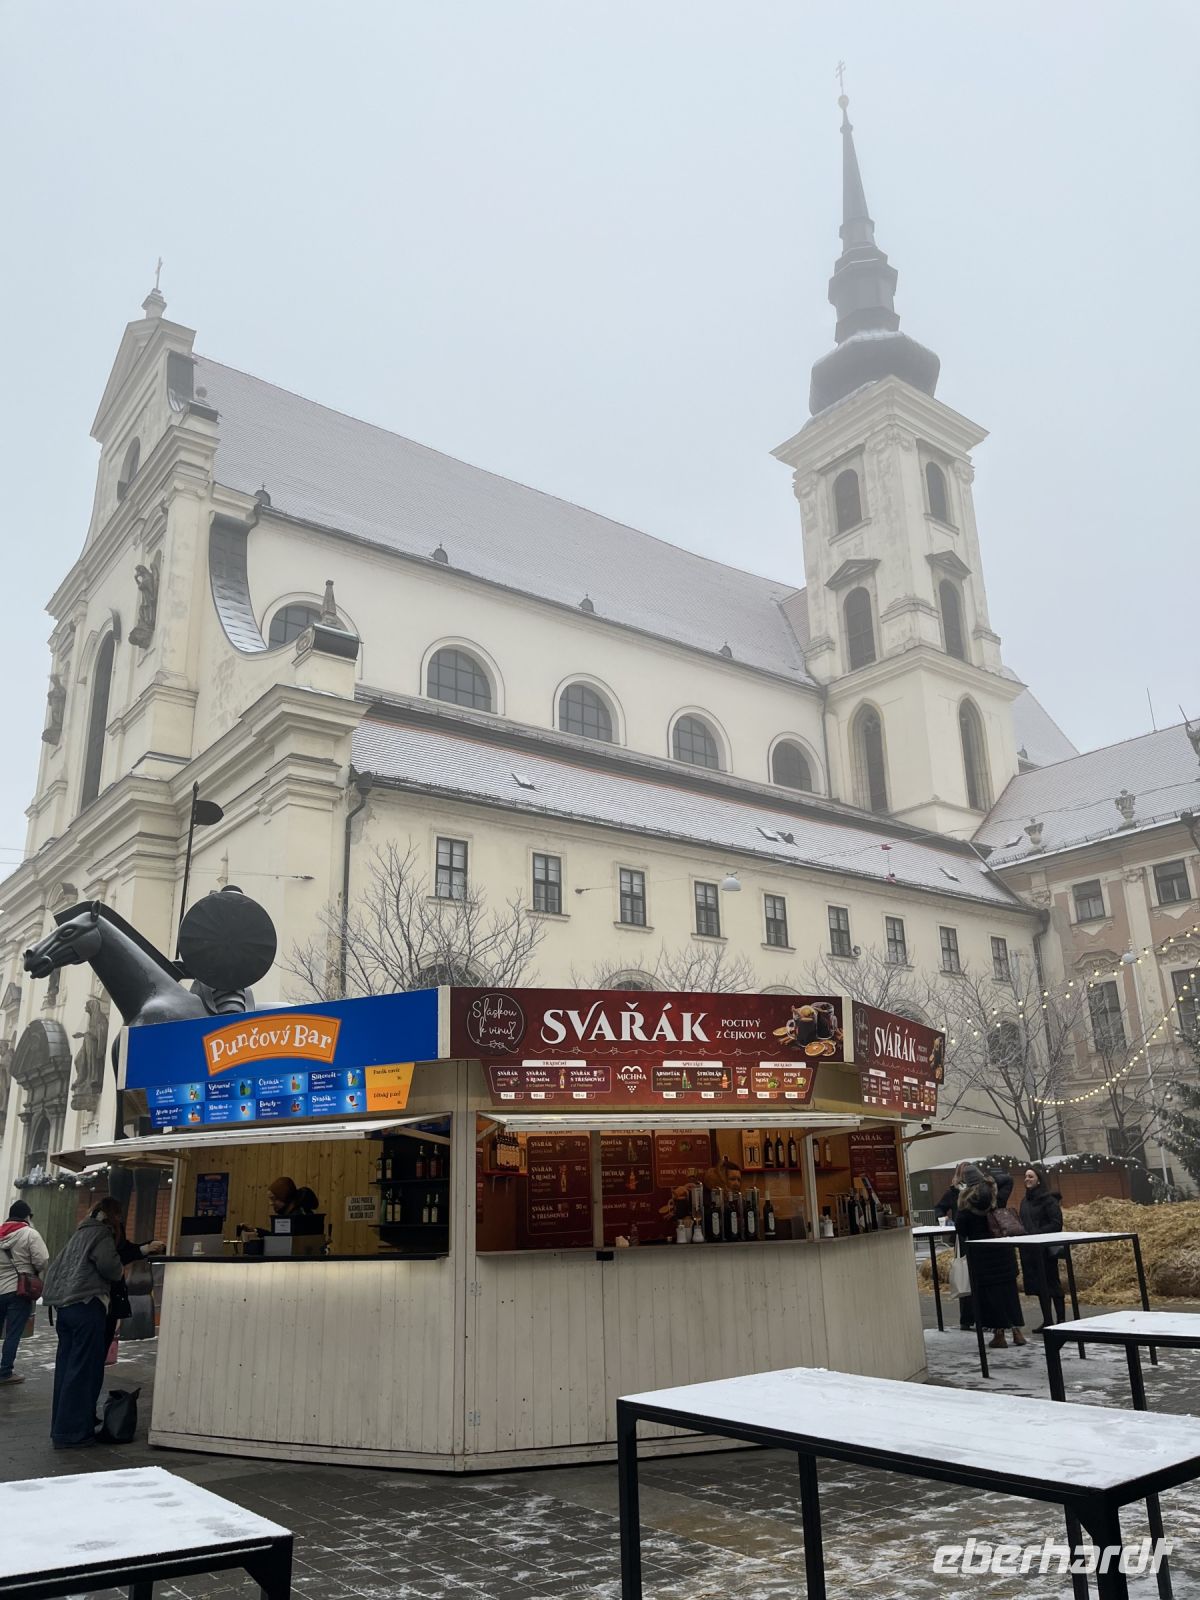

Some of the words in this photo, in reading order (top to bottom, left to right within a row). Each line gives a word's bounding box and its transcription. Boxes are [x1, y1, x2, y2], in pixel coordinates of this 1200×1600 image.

[540, 1000, 712, 1044] SVAŘÁK
[716, 1030, 722, 1039] Z
[723, 1029, 767, 1040] ČEJKOVIC
[721, 1018, 761, 1028] POCTIVÝ
[209, 1025, 291, 1063] Punčový
[293, 1024, 332, 1048] Bar
[874, 1022, 916, 1063] SVAŘÁK
[616, 1073, 647, 1081] MICHNA
